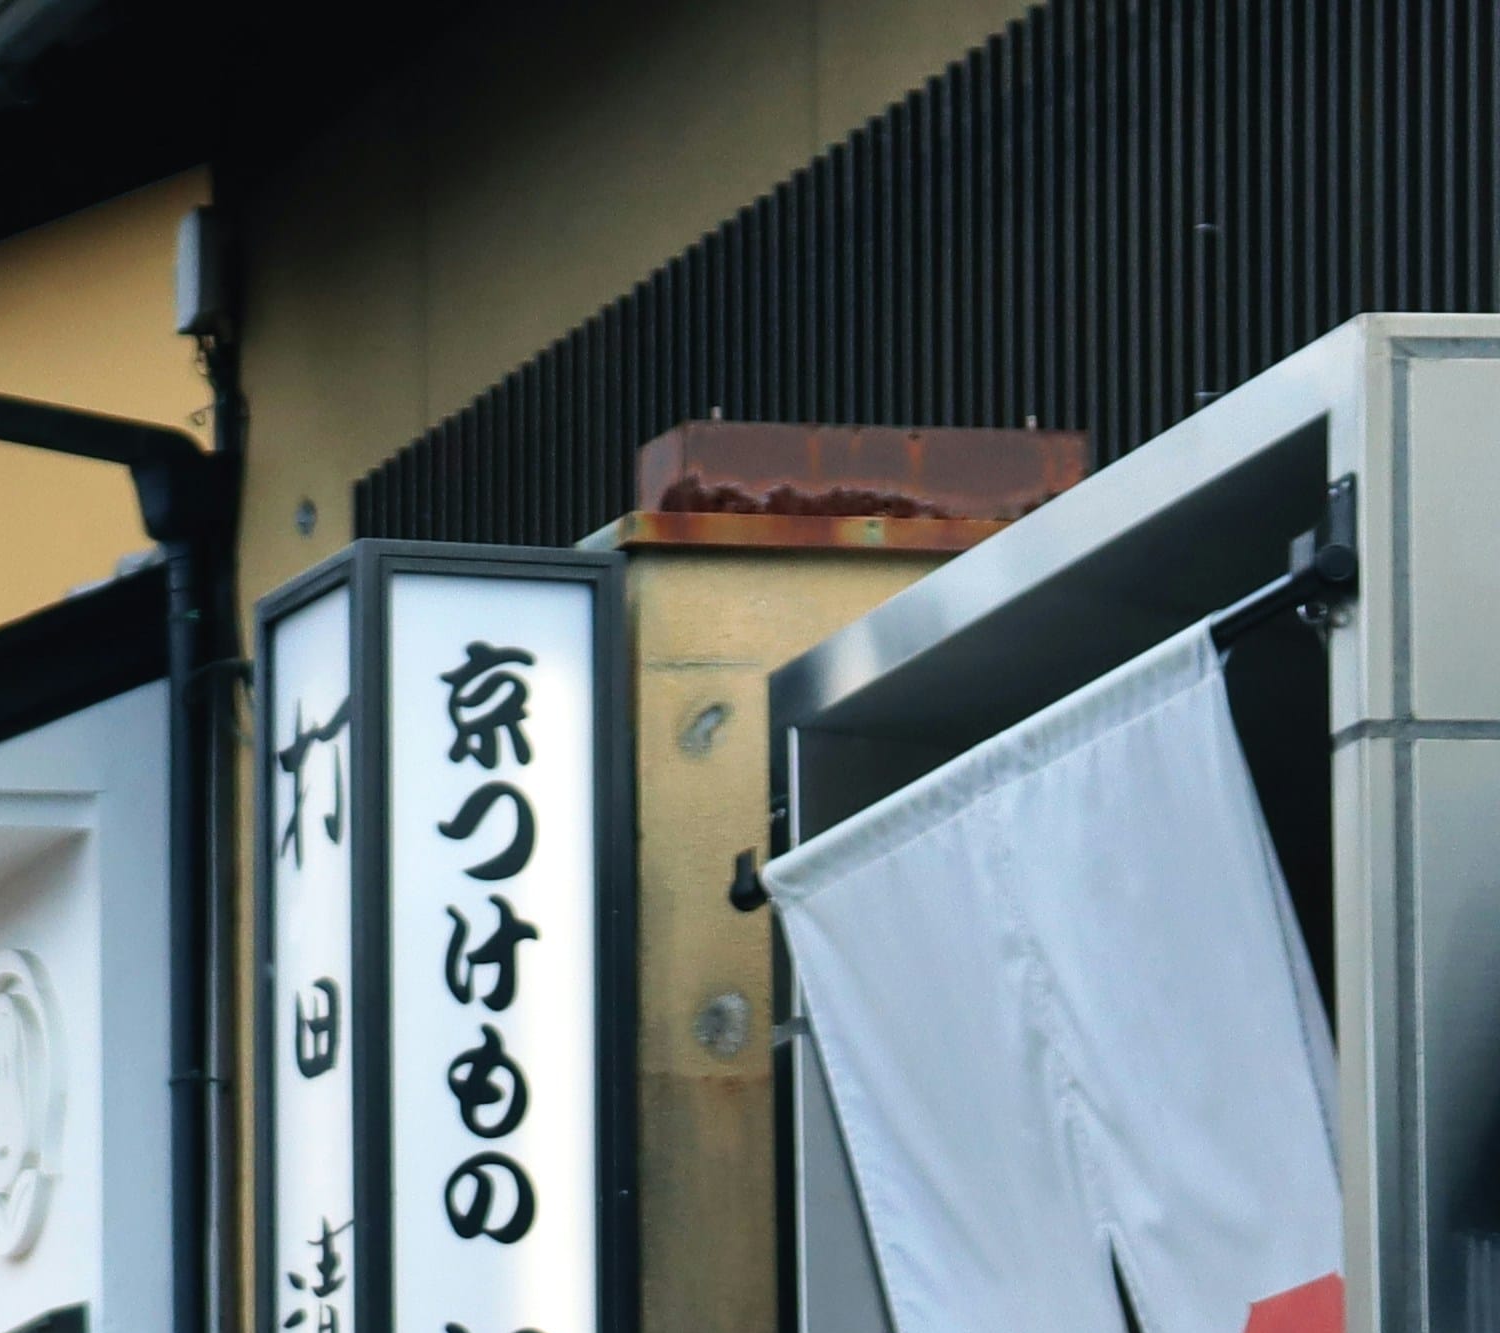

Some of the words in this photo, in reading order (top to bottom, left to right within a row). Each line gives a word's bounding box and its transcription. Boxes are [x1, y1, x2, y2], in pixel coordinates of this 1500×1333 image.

[437, 640, 541, 1247] 京つけもの
